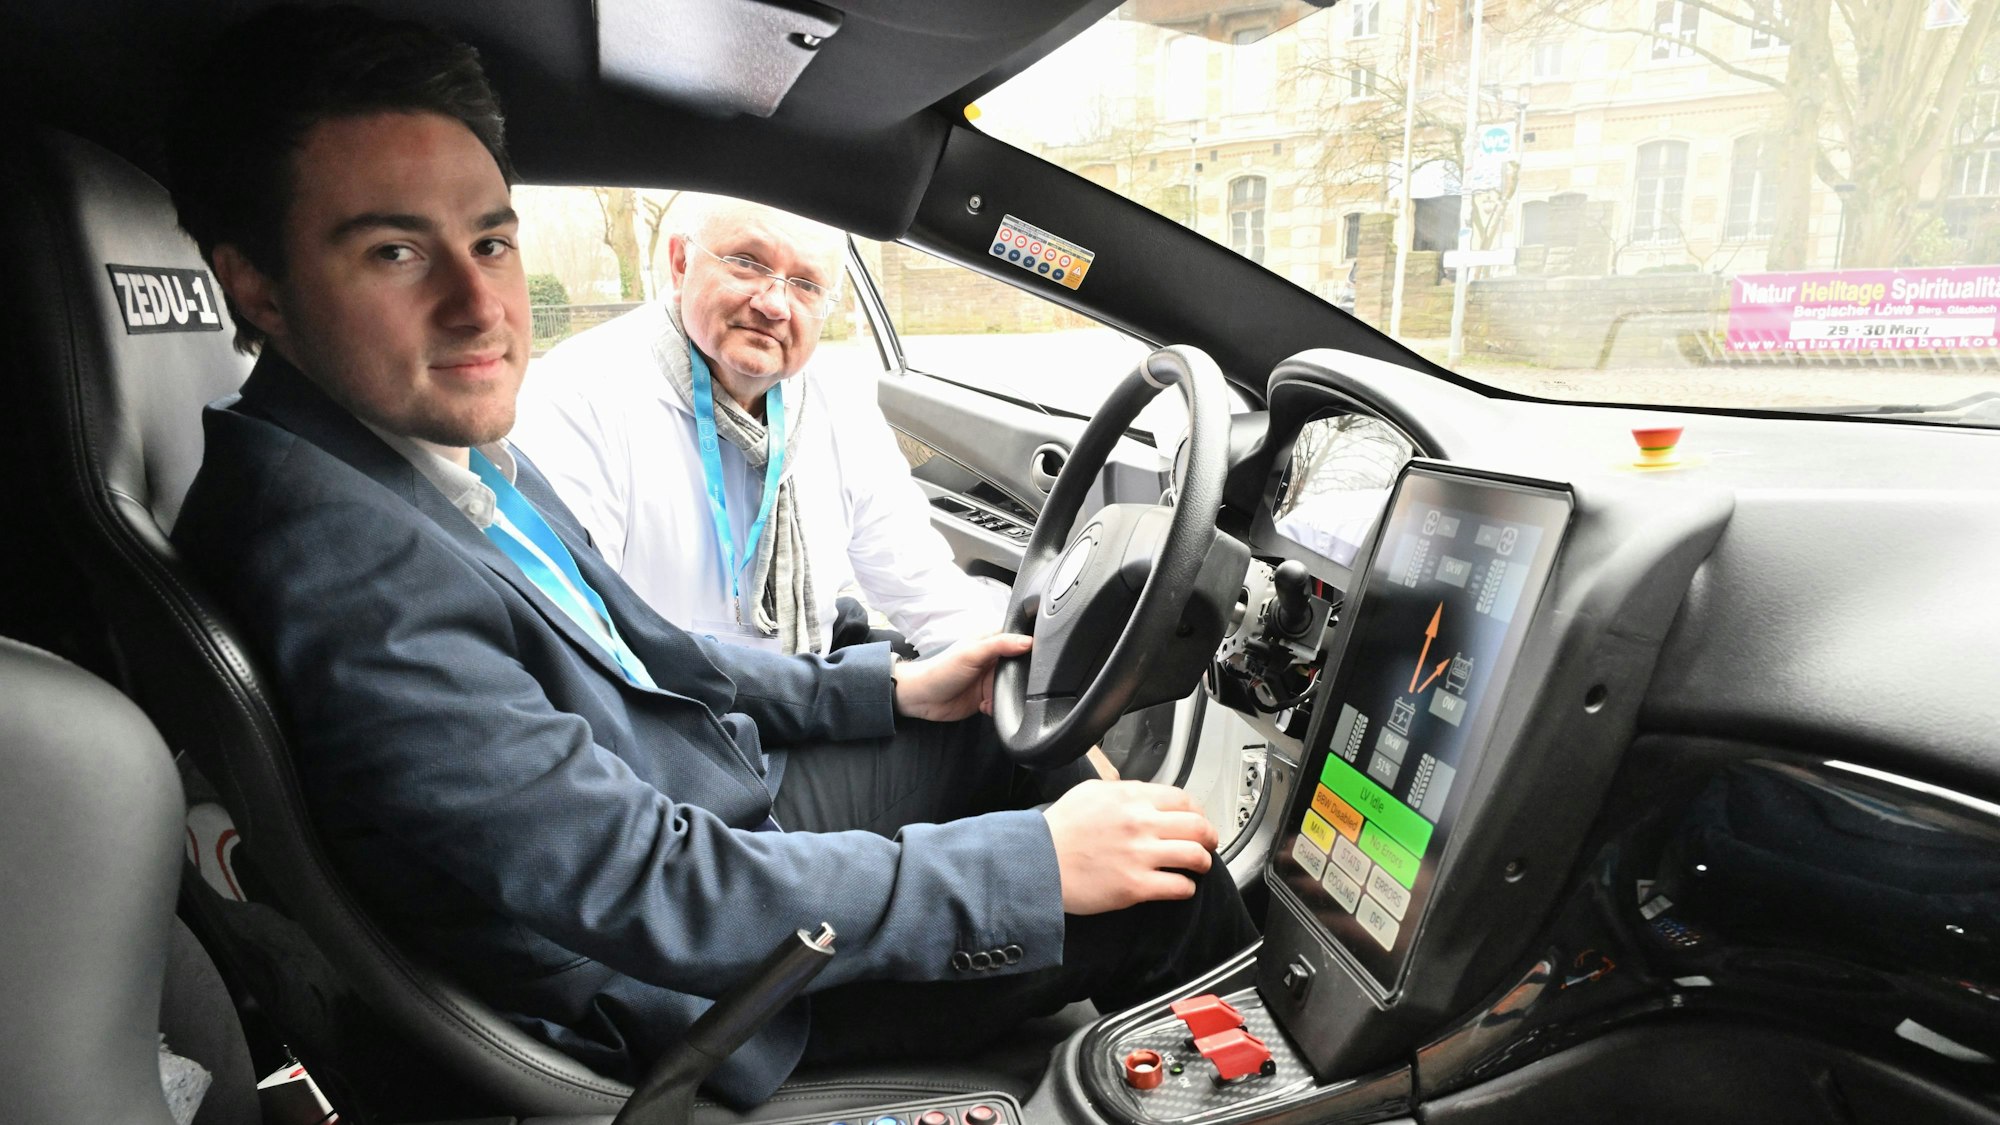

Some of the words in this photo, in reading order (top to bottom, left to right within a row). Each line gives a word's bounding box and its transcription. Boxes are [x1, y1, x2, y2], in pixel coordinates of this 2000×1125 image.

[114, 272, 218, 326] ZEDU-1
[1742, 282, 1797, 304] Natur
[1800, 280, 1885, 306] Heiltage
[1793, 304, 1871, 319] Bergischer
[1827, 325, 1849, 336] 29
[1862, 324, 1886, 336] 30
[1376, 757, 1392, 776] 51%
[1360, 787, 1371, 801] LV
[1370, 793, 1384, 814] Idle
[1330, 803, 1359, 831] Disabled
[1310, 820, 1326, 841] MAIN
[1298, 843, 1321, 872] CHARGE
[1341, 847, 1361, 872] STATS
[1369, 834, 1381, 851] No
[1380, 843, 1404, 869] Errors
[1328, 871, 1355, 904] COOLING
[1374, 876, 1402, 908] ERRORS
[1369, 911, 1386, 931] DEV
